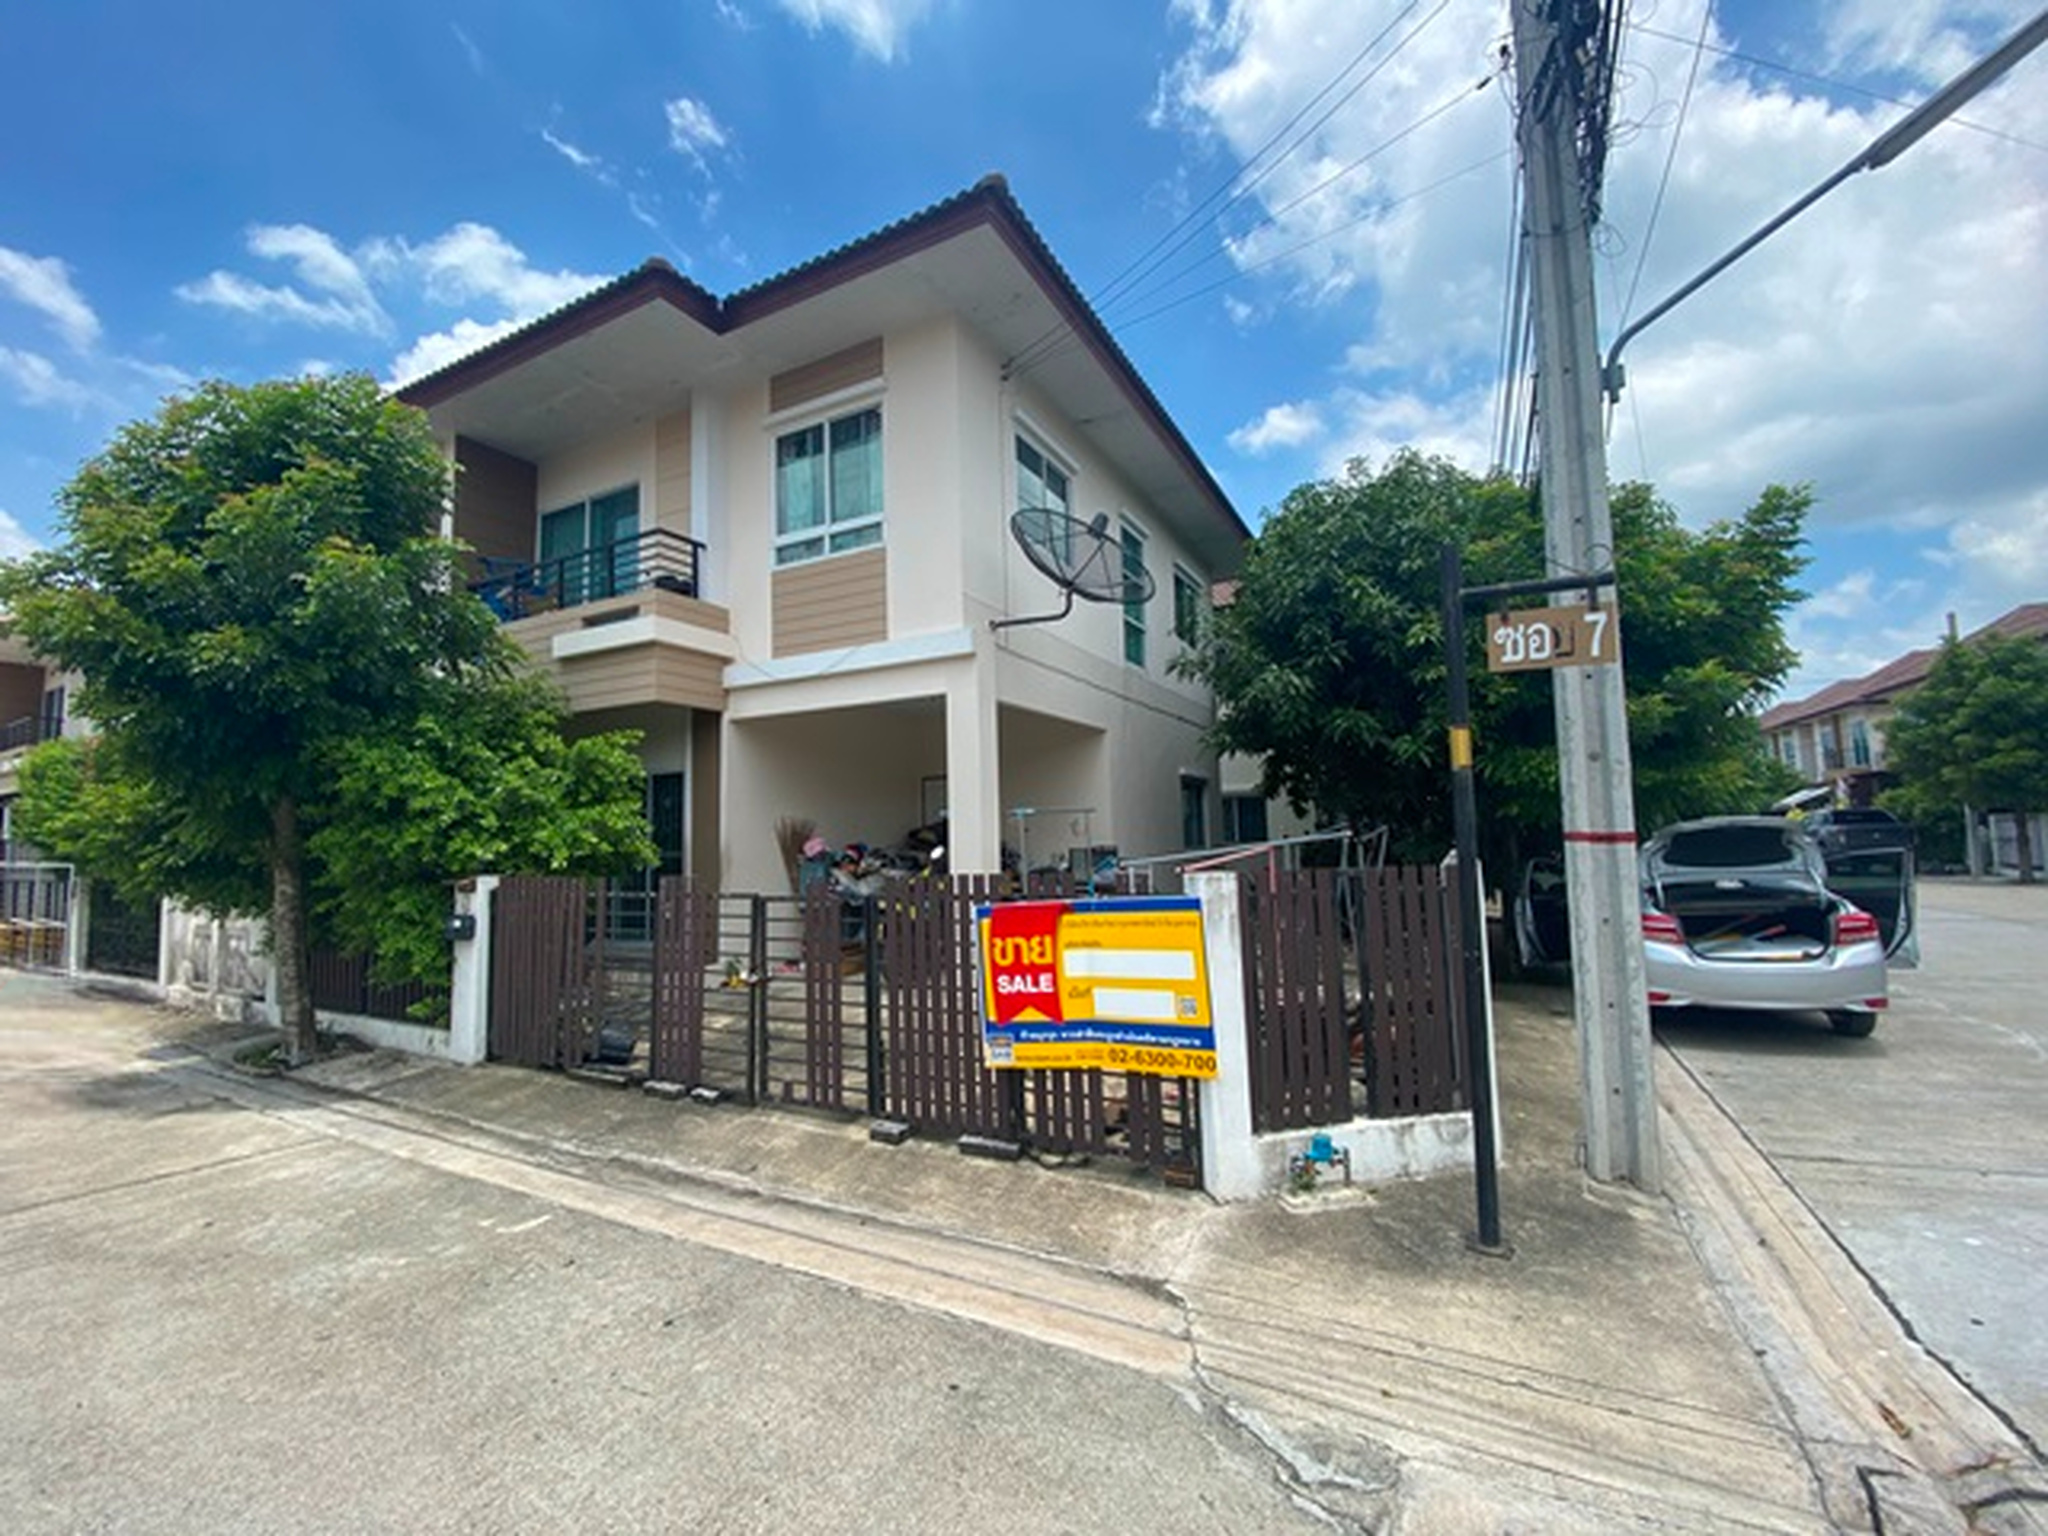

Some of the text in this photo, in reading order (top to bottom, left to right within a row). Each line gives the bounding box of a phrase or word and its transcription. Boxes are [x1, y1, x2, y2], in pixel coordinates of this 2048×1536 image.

[1583, 612, 1608, 656] 7
[992, 934, 1052, 966] ขาย
[997, 972, 1054, 994] SALE
[1107, 1047, 1217, 1072] 02-6300-700
